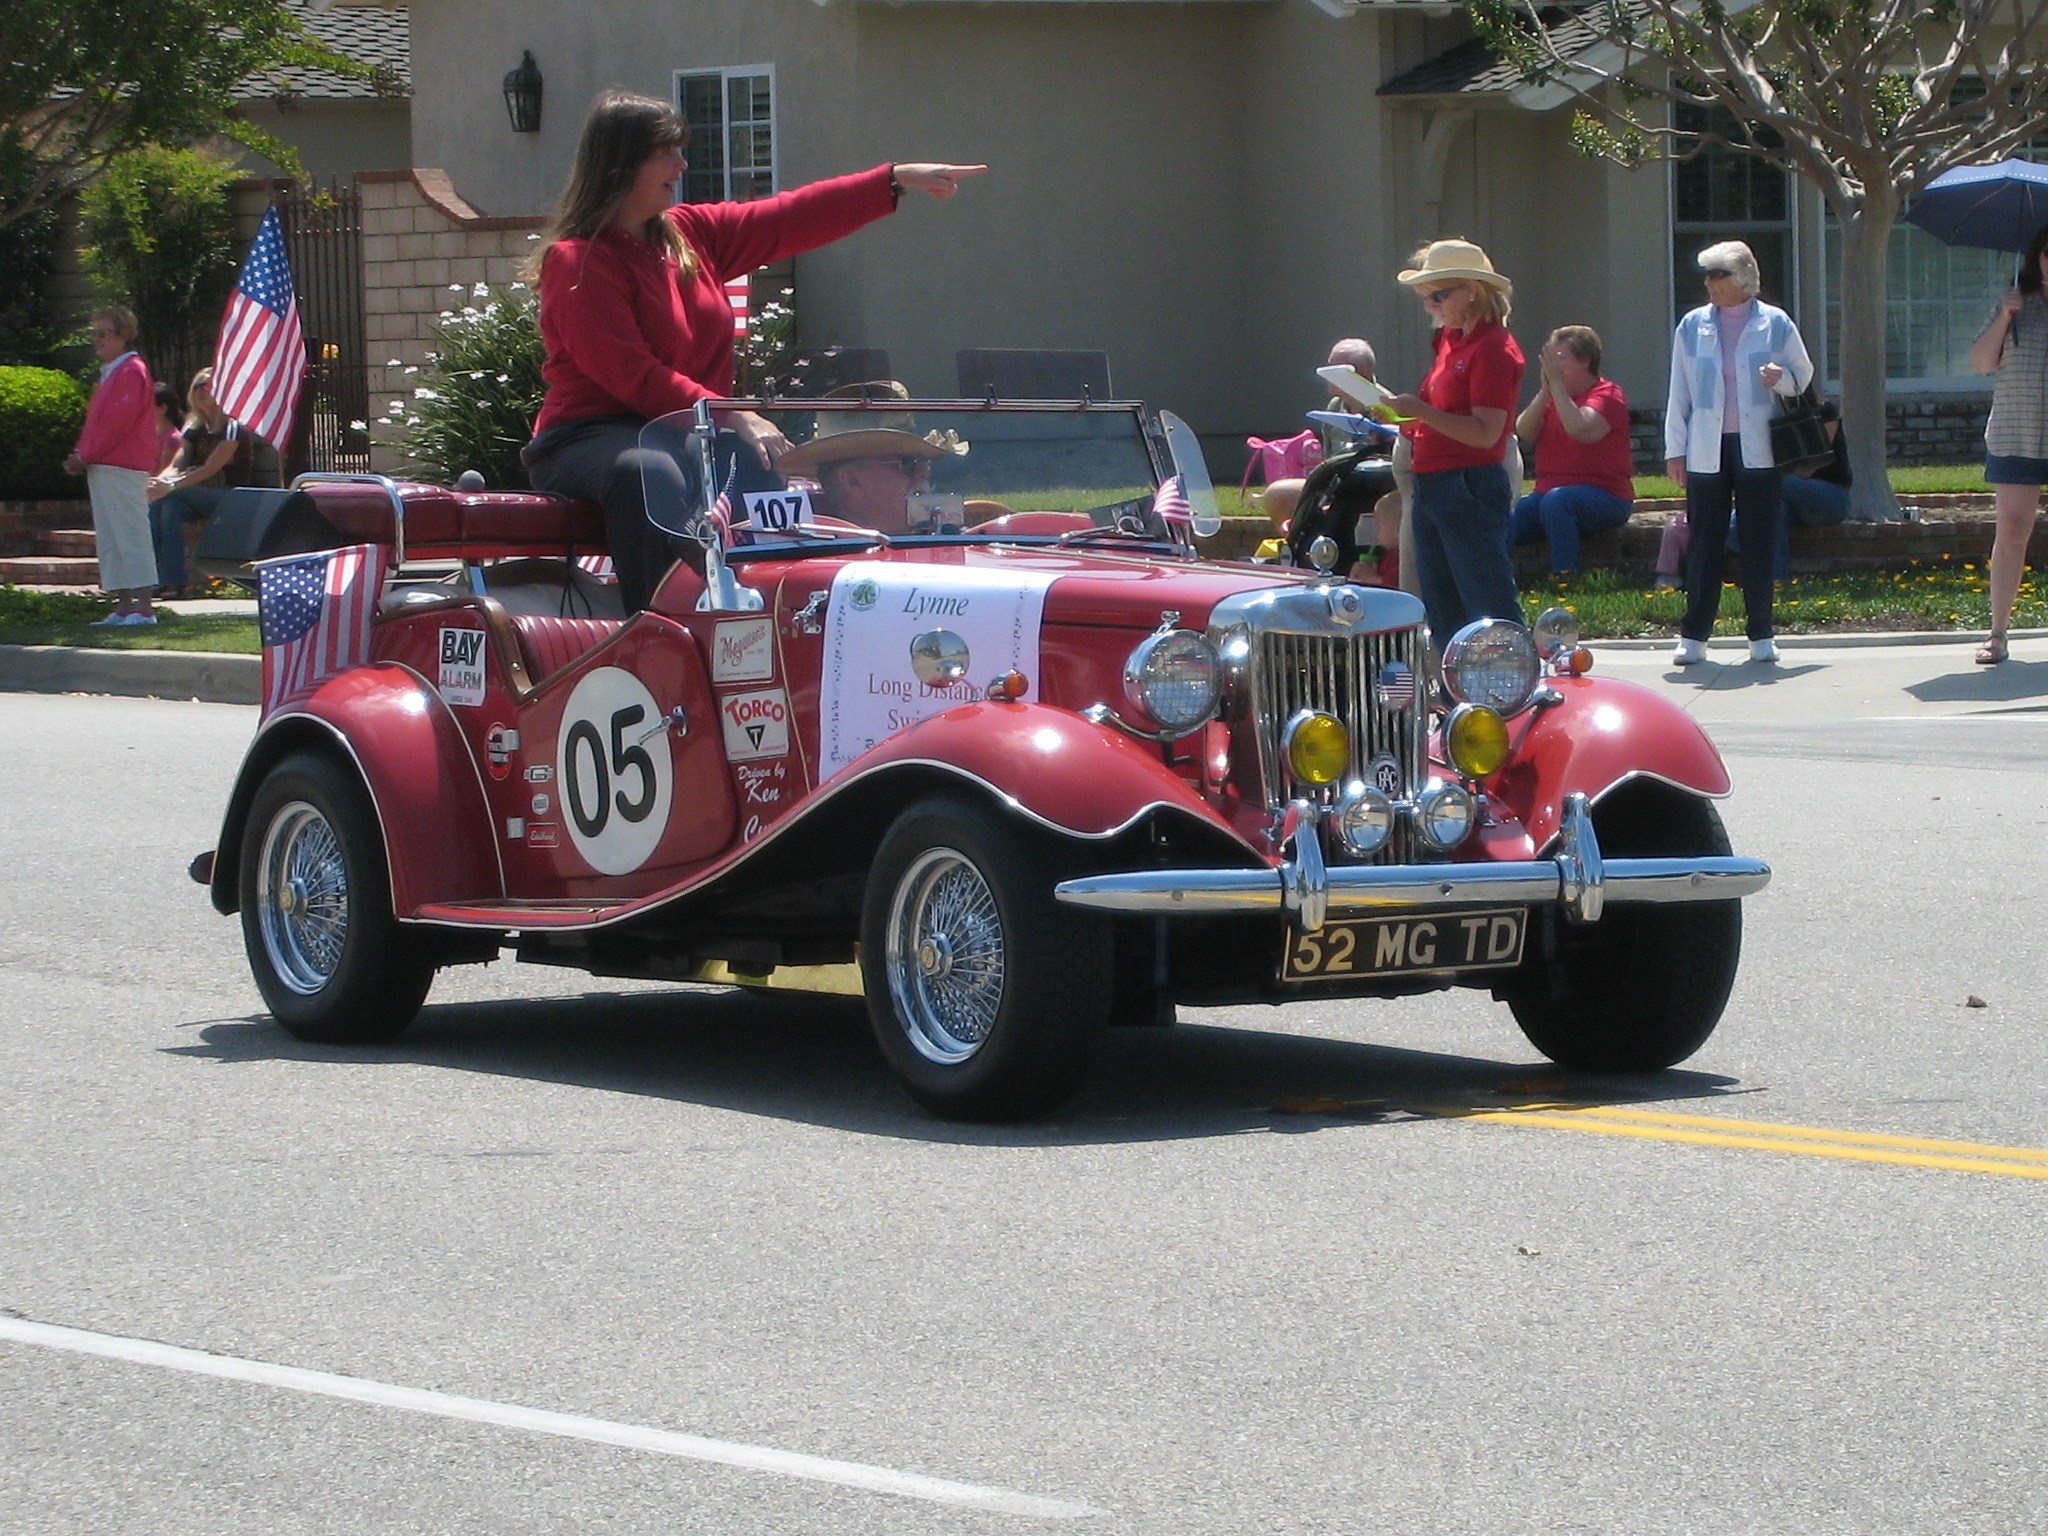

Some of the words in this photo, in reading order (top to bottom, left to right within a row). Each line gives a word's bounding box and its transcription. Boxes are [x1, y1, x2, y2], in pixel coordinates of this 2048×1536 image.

[754, 496, 803, 529] 107
[903, 587, 970, 621] Lynne
[441, 630, 485, 667] BAY
[439, 669, 482, 691] ALARM
[868, 672, 912, 703] Long
[724, 698, 785, 727] TORCO
[565, 704, 657, 838] 05
[737, 765, 771, 780] Driven
[774, 761, 786, 779] by
[744, 779, 780, 803] Ken
[1292, 926, 1357, 973] 52
[1374, 921, 1439, 969] MG
[1460, 916, 1518, 962] TD
